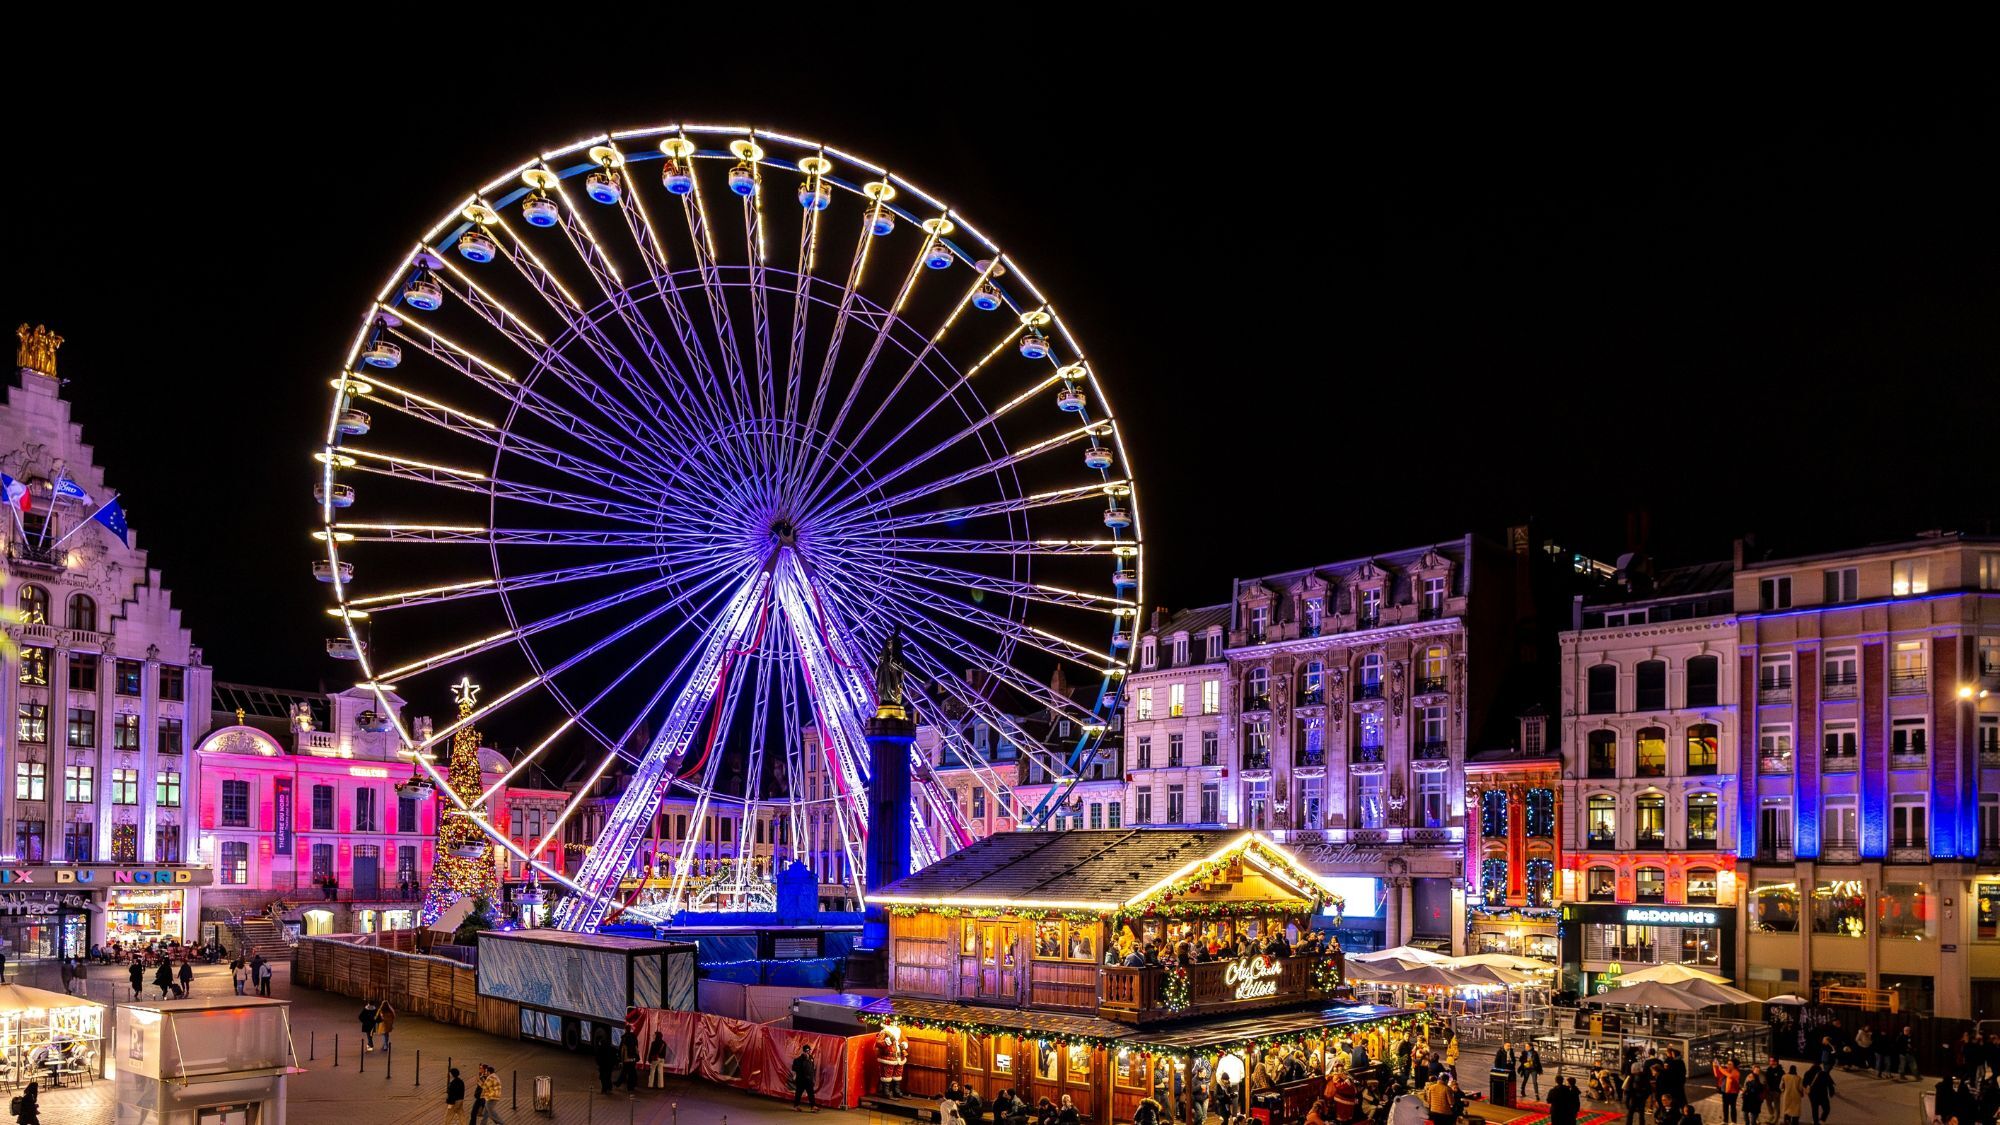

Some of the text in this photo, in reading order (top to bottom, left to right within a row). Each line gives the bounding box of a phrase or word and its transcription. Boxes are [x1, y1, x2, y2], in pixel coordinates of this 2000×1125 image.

[57, 870, 95, 883] DU
[115, 870, 192, 883] NORD
[45, 891, 91, 909] PLACE
[1626, 909, 1716, 924] McDonald's
